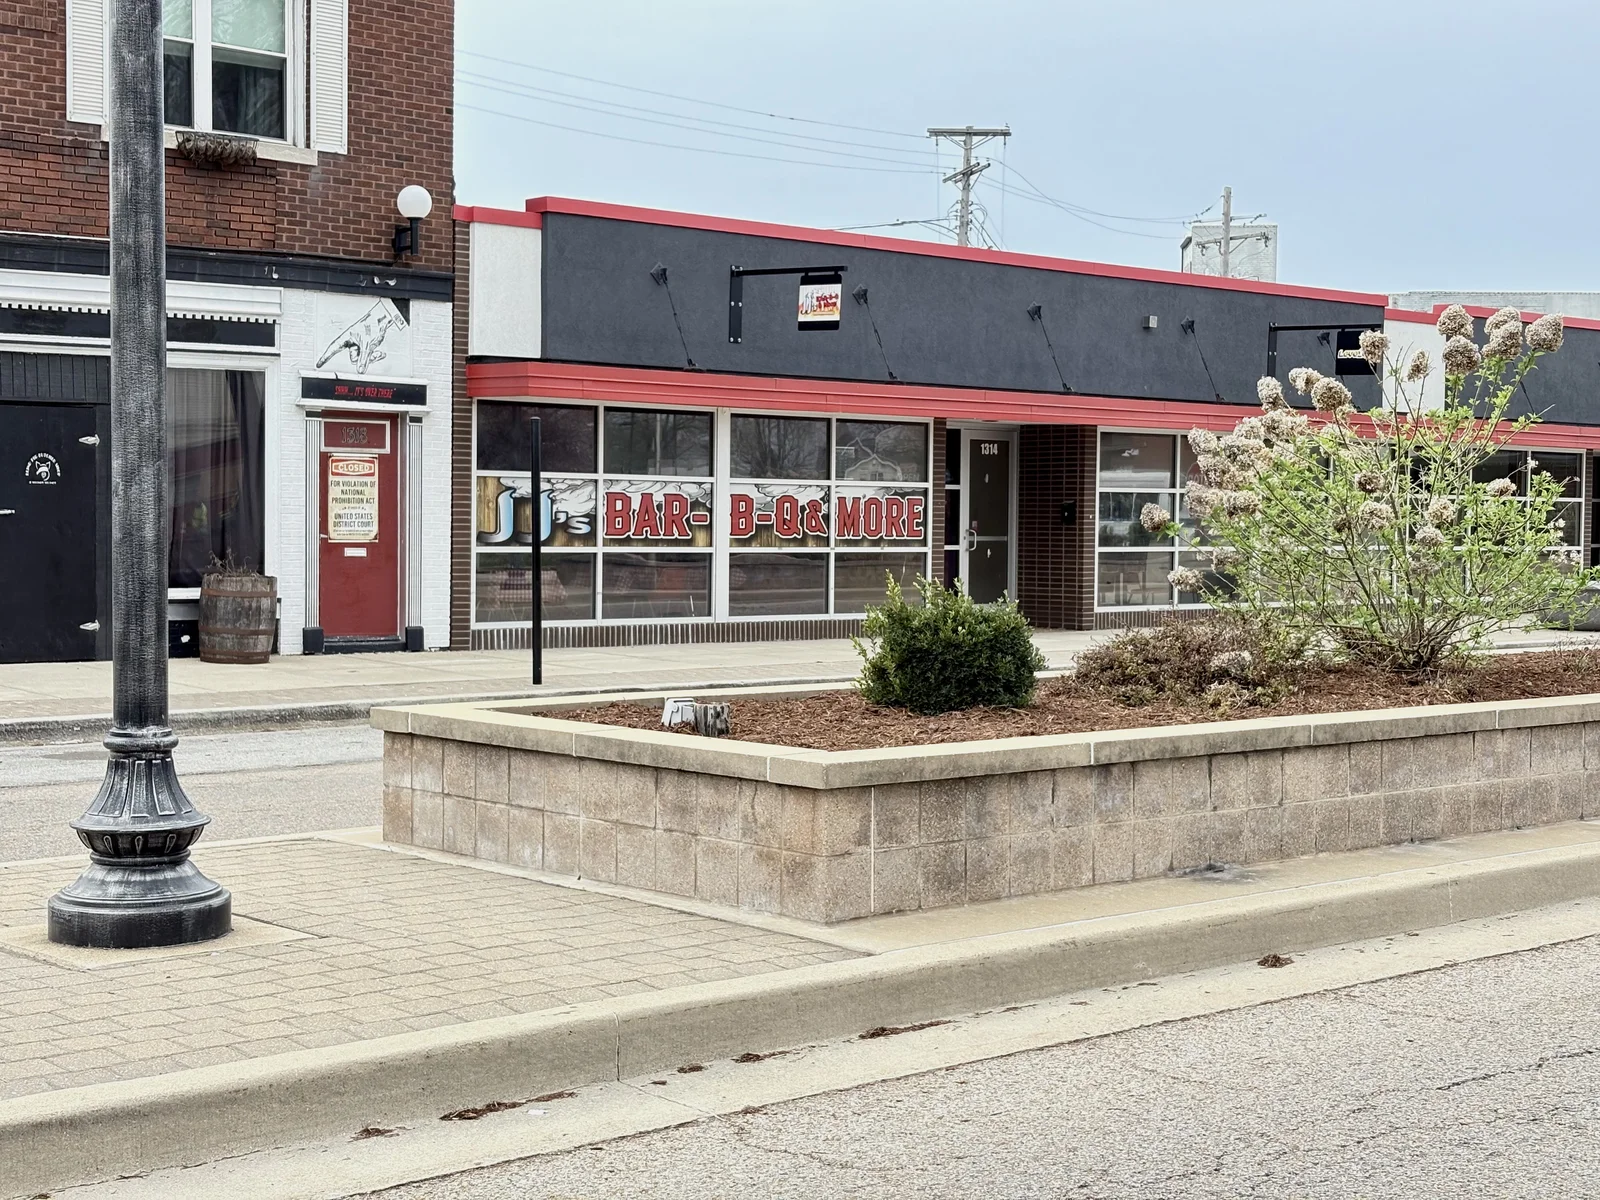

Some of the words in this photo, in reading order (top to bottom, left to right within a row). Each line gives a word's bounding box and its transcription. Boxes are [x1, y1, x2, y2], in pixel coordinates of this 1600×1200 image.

[980, 443, 999, 455] 1314
[338, 463, 370, 472] CLOSED
[330, 480, 341, 488] FOR
[342, 480, 369, 488] VIOLATION
[369, 480, 377, 488] OF
[340, 489, 367, 497] NATIONAL
[331, 497, 365, 505] PROHIBITION
[365, 497, 376, 505] ACT
[334, 512, 354, 520] UNITED
[354, 512, 373, 520] STATES
[835, 495, 925, 540] MORE
[332, 520, 356, 528] DISTRICT
[356, 520, 374, 528] COURT
